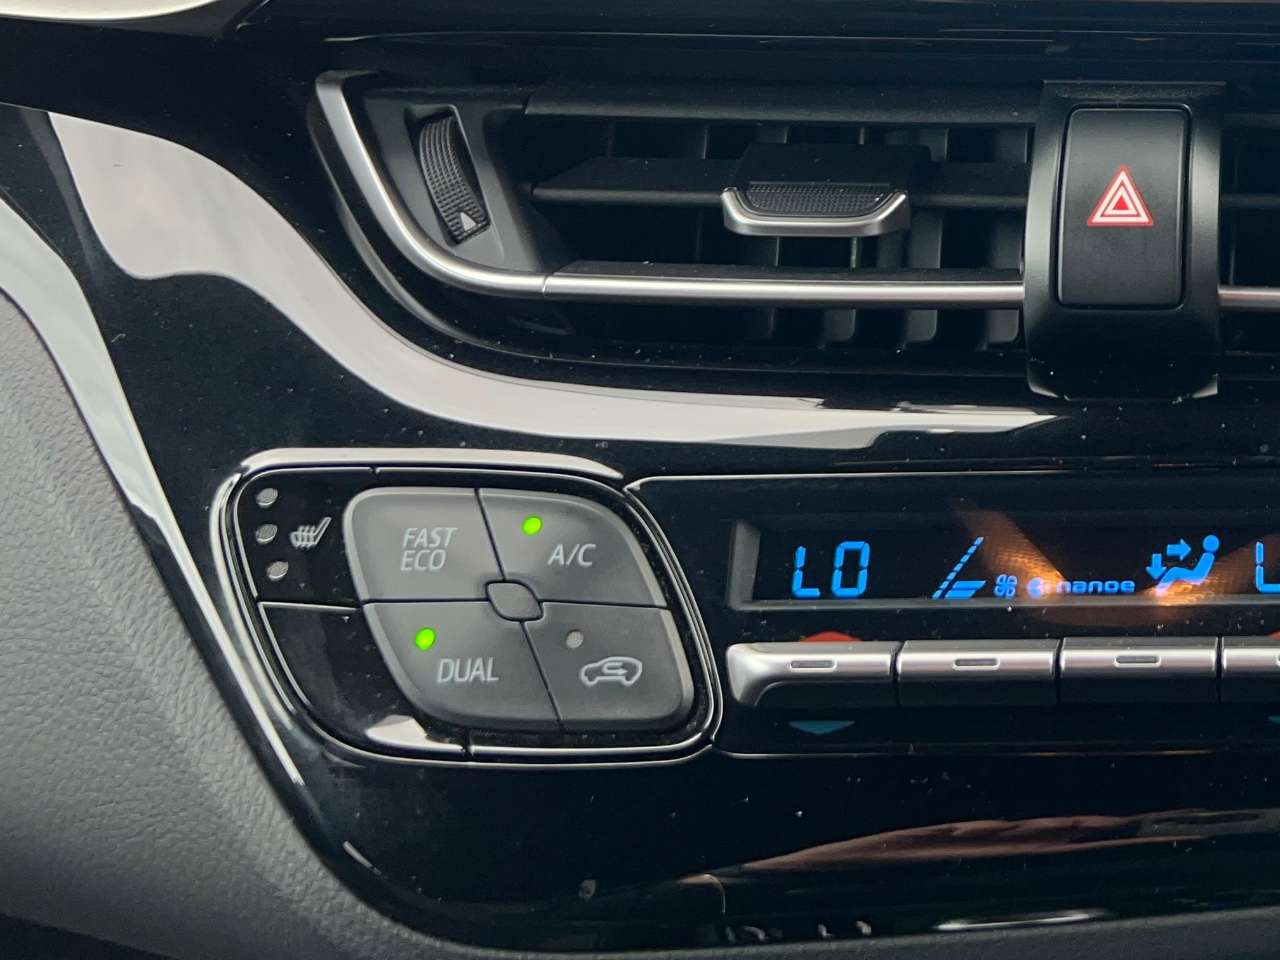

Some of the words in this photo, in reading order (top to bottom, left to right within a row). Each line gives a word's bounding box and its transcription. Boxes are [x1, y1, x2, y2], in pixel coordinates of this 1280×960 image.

[402, 526, 458, 549] FAST
[400, 548, 448, 573] ECO
[547, 543, 597, 569] A/C
[791, 540, 870, 600] LO
[1056, 579, 1137, 595] nanoe
[436, 657, 500, 684] DUAL
